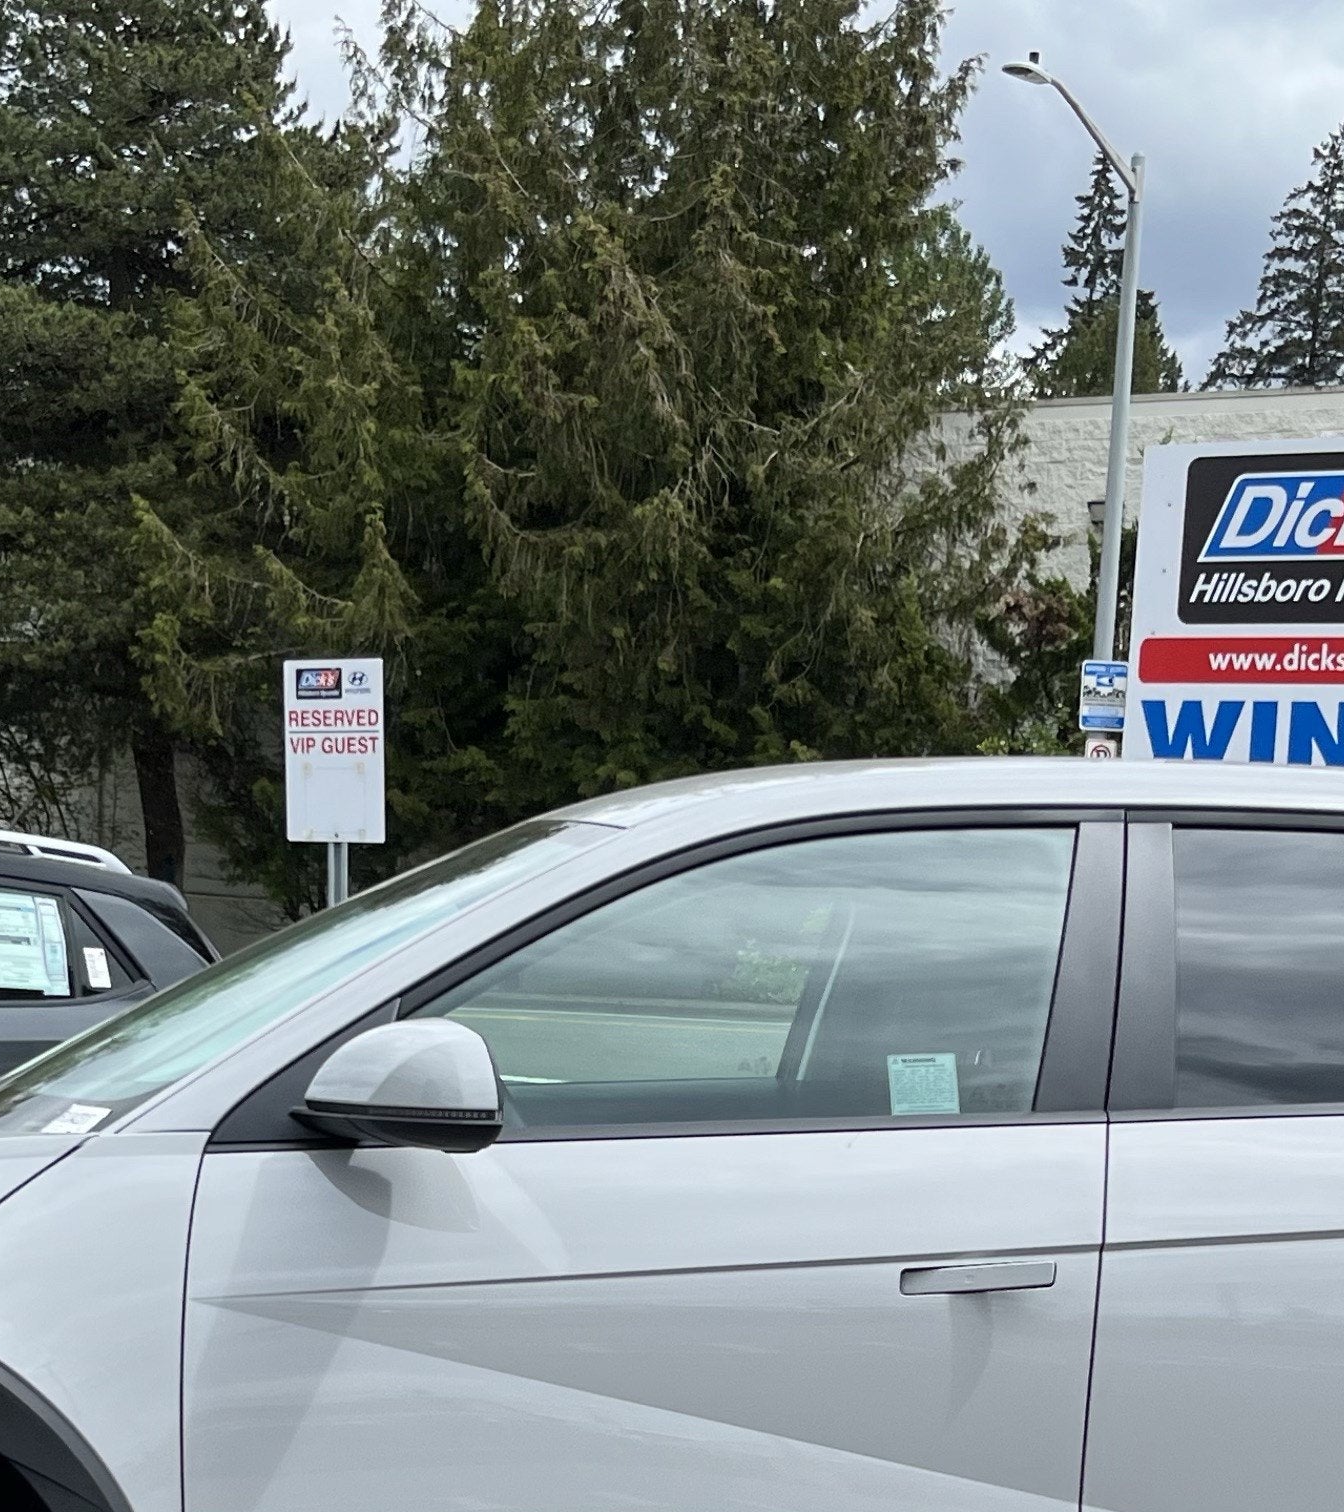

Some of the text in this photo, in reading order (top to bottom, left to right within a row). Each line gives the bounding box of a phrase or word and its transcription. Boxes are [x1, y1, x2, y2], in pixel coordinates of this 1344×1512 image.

[1189, 572, 1331, 603] Hillsboro
[288, 709, 379, 728] RESERVED
[290, 736, 379, 754] VIP GUEST
